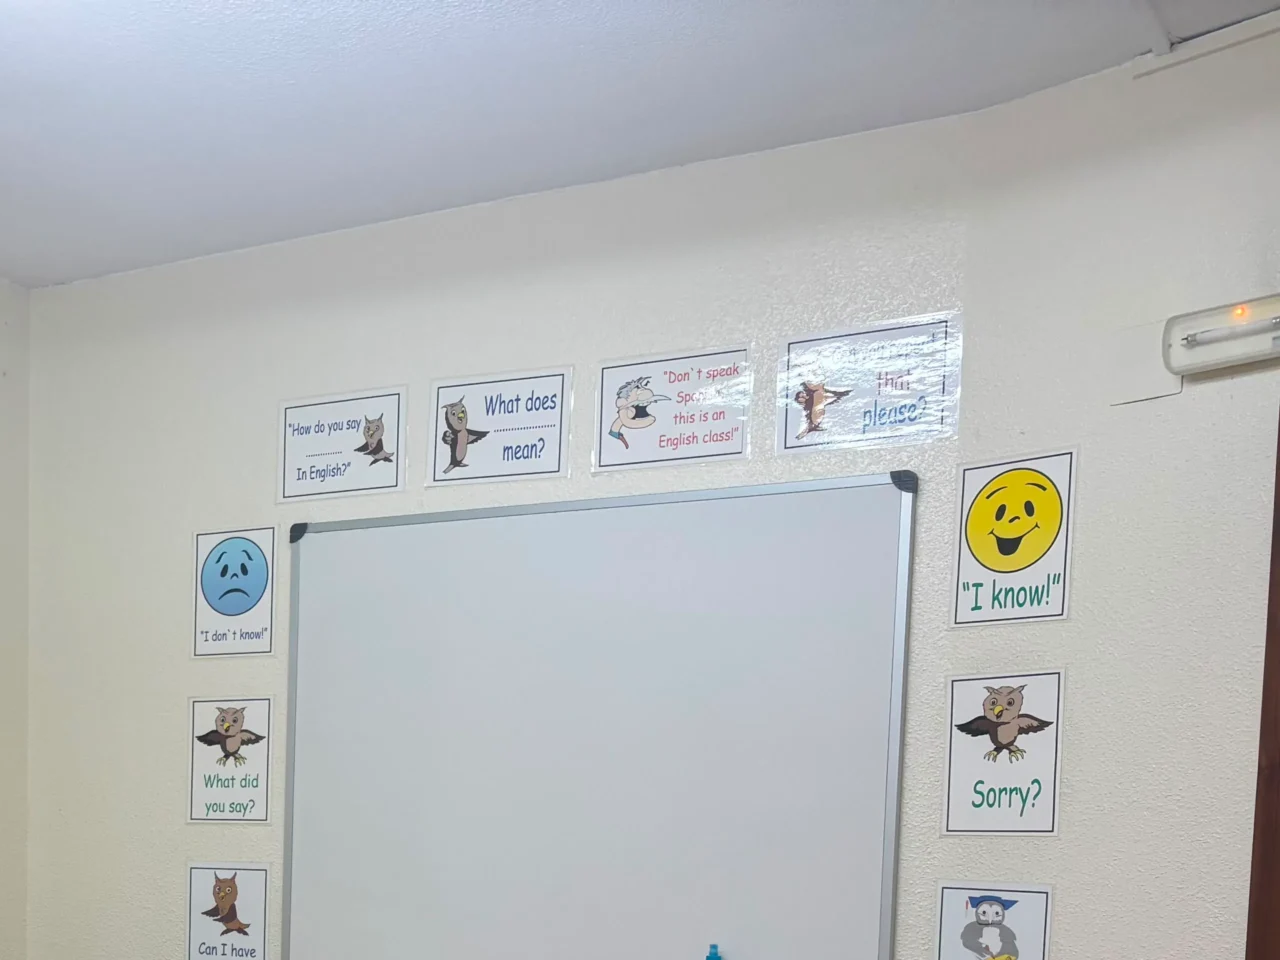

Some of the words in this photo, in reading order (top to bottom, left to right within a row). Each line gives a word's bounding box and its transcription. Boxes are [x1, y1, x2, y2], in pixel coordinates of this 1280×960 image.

[705, 361, 740, 382] speak
[484, 392, 521, 417] What
[525, 389, 558, 412] does
[672, 411, 696, 426] this
[699, 409, 709, 423] is
[711, 409, 726, 421] an
[313, 419, 326, 434] do
[327, 420, 344, 437] you
[345, 419, 362, 433] say
[502, 436, 546, 462] mean?
[658, 431, 699, 451] English
[296, 467, 308, 481] In
[991, 572, 1062, 610] know!"
[203, 772, 237, 789] What
[239, 772, 260, 789] did
[971, 777, 1043, 817] Sorry?
[204, 801, 226, 818] you
[228, 798, 256, 818] say?
[197, 941, 218, 957] Can
[220, 943, 228, 956] I
[230, 942, 257, 958] have
